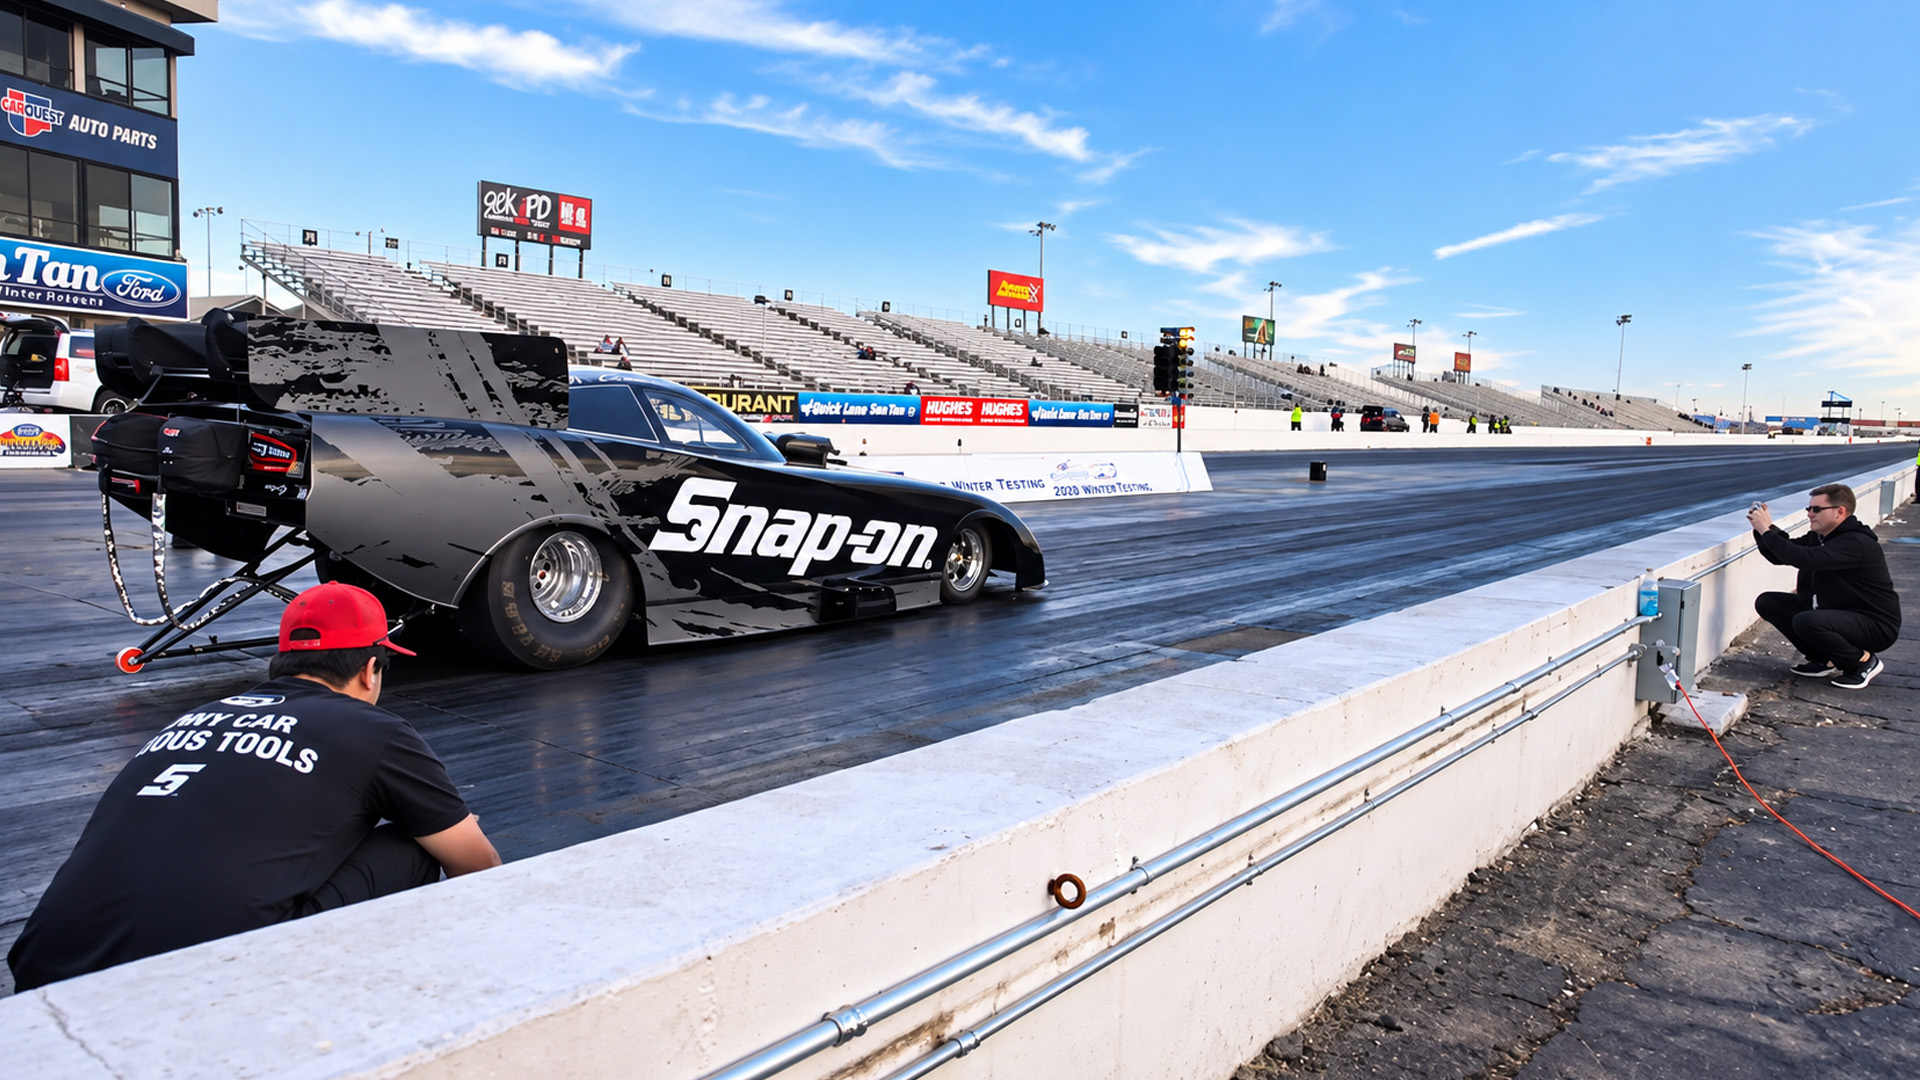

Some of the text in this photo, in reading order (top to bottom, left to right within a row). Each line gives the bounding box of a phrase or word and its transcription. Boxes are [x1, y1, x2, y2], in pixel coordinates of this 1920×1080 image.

[69, 114, 109, 138] AUTO
[112, 125, 158, 150] PARTS
[15, 246, 101, 292] Tan
[116, 273, 166, 302] Ford
[925, 401, 973, 416] HUGHES
[981, 402, 1023, 416] HUGHES
[951, 478, 1046, 492] WINTER TESTING
[1053, 485, 1080, 497] 2020
[648, 476, 939, 576] Snap-on
[232, 713, 299, 734] CAR
[216, 731, 319, 774] TOOLS
